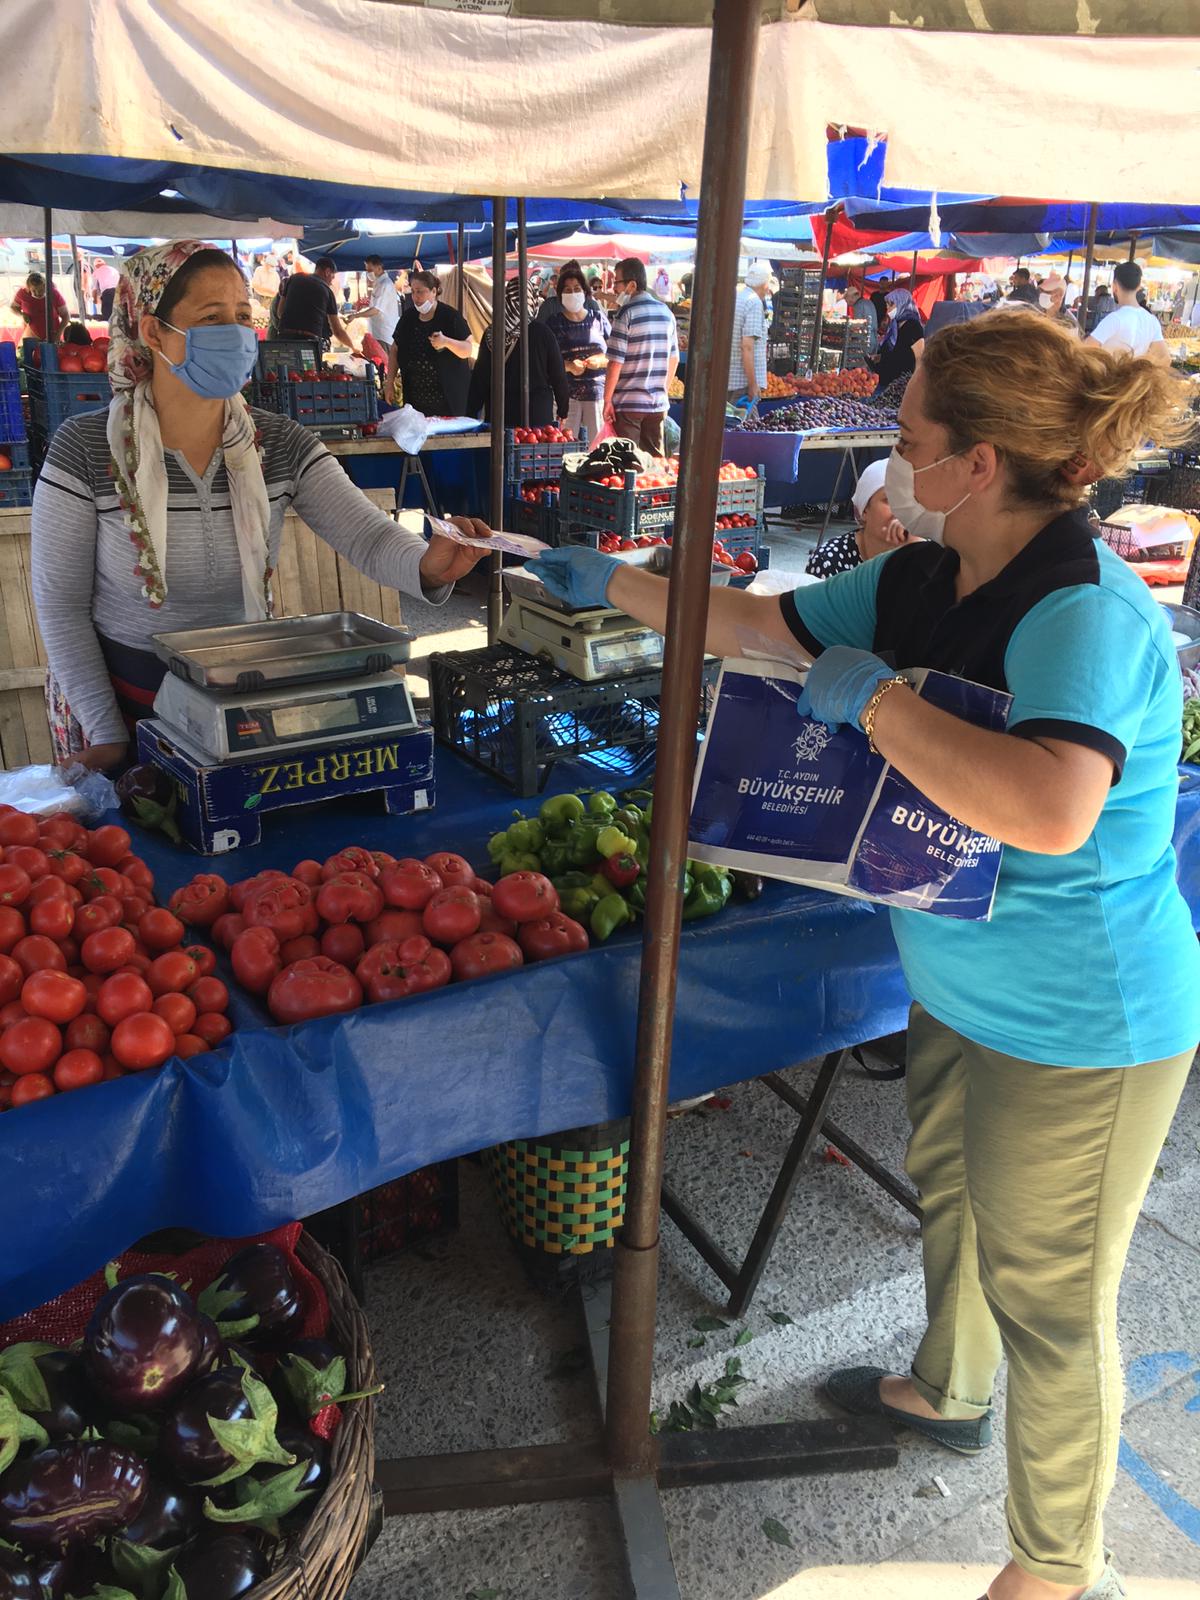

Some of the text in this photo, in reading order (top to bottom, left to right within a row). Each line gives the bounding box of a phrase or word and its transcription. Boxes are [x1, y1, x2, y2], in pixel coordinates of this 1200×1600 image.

[640, 511, 675, 521] ÖDENLE
[259, 744, 400, 794] MERPEZ
[778, 769, 820, 782] T.C. AYDIN
[737, 777, 845, 805] BÜYÜKŞEHİR
[761, 801, 808, 815] BELEDİYESİ
[926, 844, 980, 868] BELEDİYESİ
